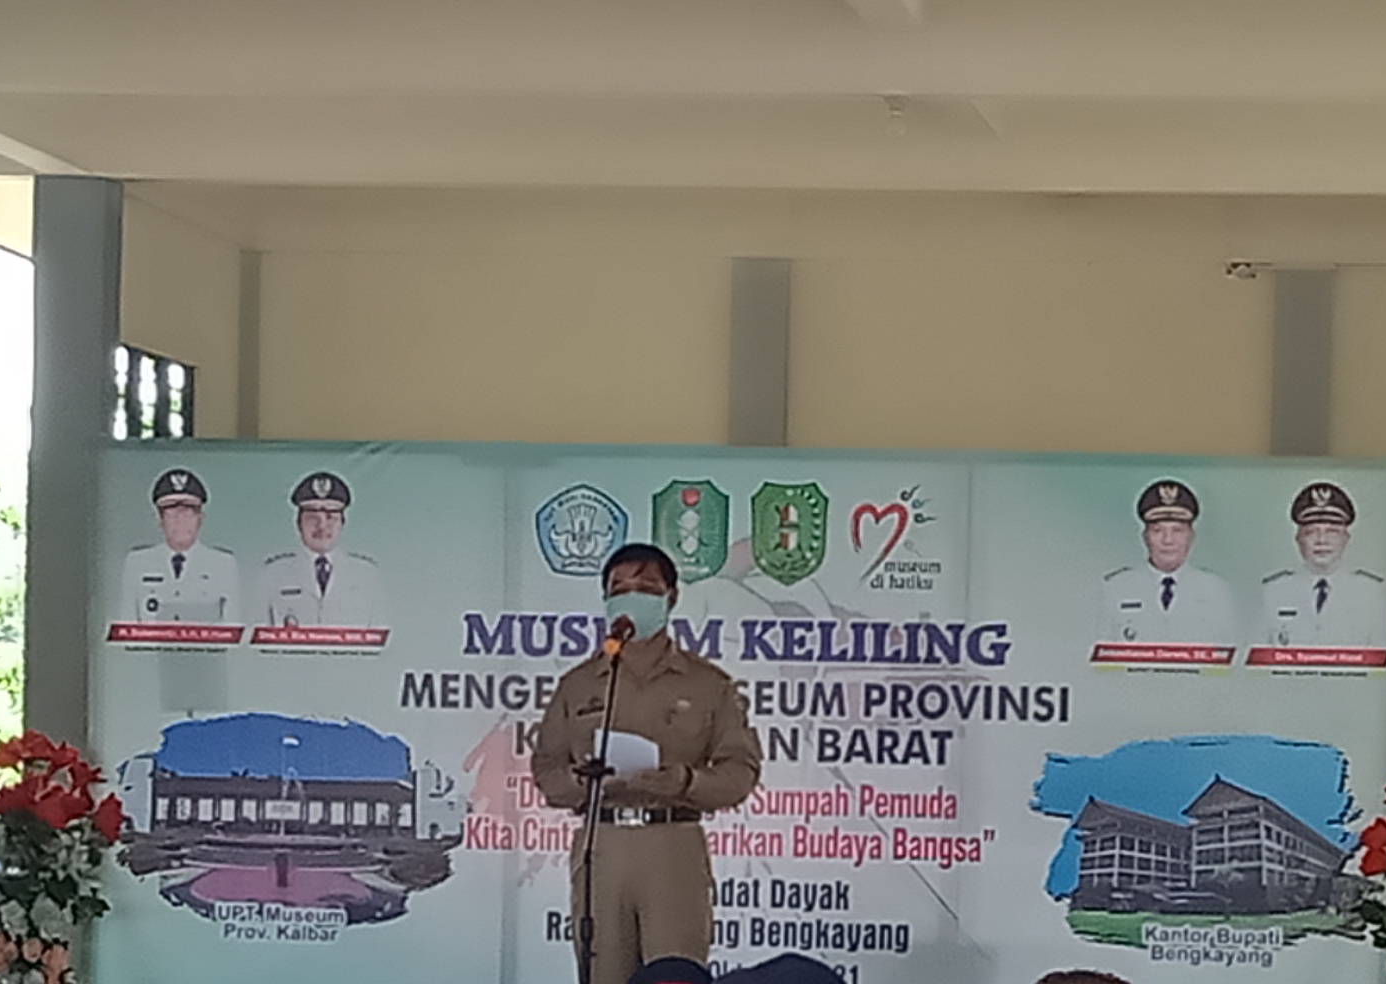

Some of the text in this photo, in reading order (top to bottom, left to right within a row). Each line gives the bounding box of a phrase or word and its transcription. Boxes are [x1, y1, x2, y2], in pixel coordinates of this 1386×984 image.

[870, 574, 933, 589] di hatiku
[884, 562, 941, 573] museum
[463, 613, 1011, 666] MUSM KELILING
[400, 673, 1069, 722] MENGE SEUM PROVINSI
[817, 728, 953, 765] BARAT
[750, 784, 849, 824] Sumpah
[859, 784, 957, 819] Pemuda
[466, 815, 513, 850] Kita
[523, 817, 571, 850] Cint
[708, 824, 782, 858] arikan
[793, 825, 881, 867] Budaya
[714, 878, 849, 912] dat Dayak
[217, 904, 344, 923] UPT. Museum
[224, 923, 338, 941] Prov. Kalbar
[750, 917, 909, 952] Bengkayang
[1145, 926, 1280, 946] Kantor Bupati
[1151, 945, 1273, 967] Bengkayang
